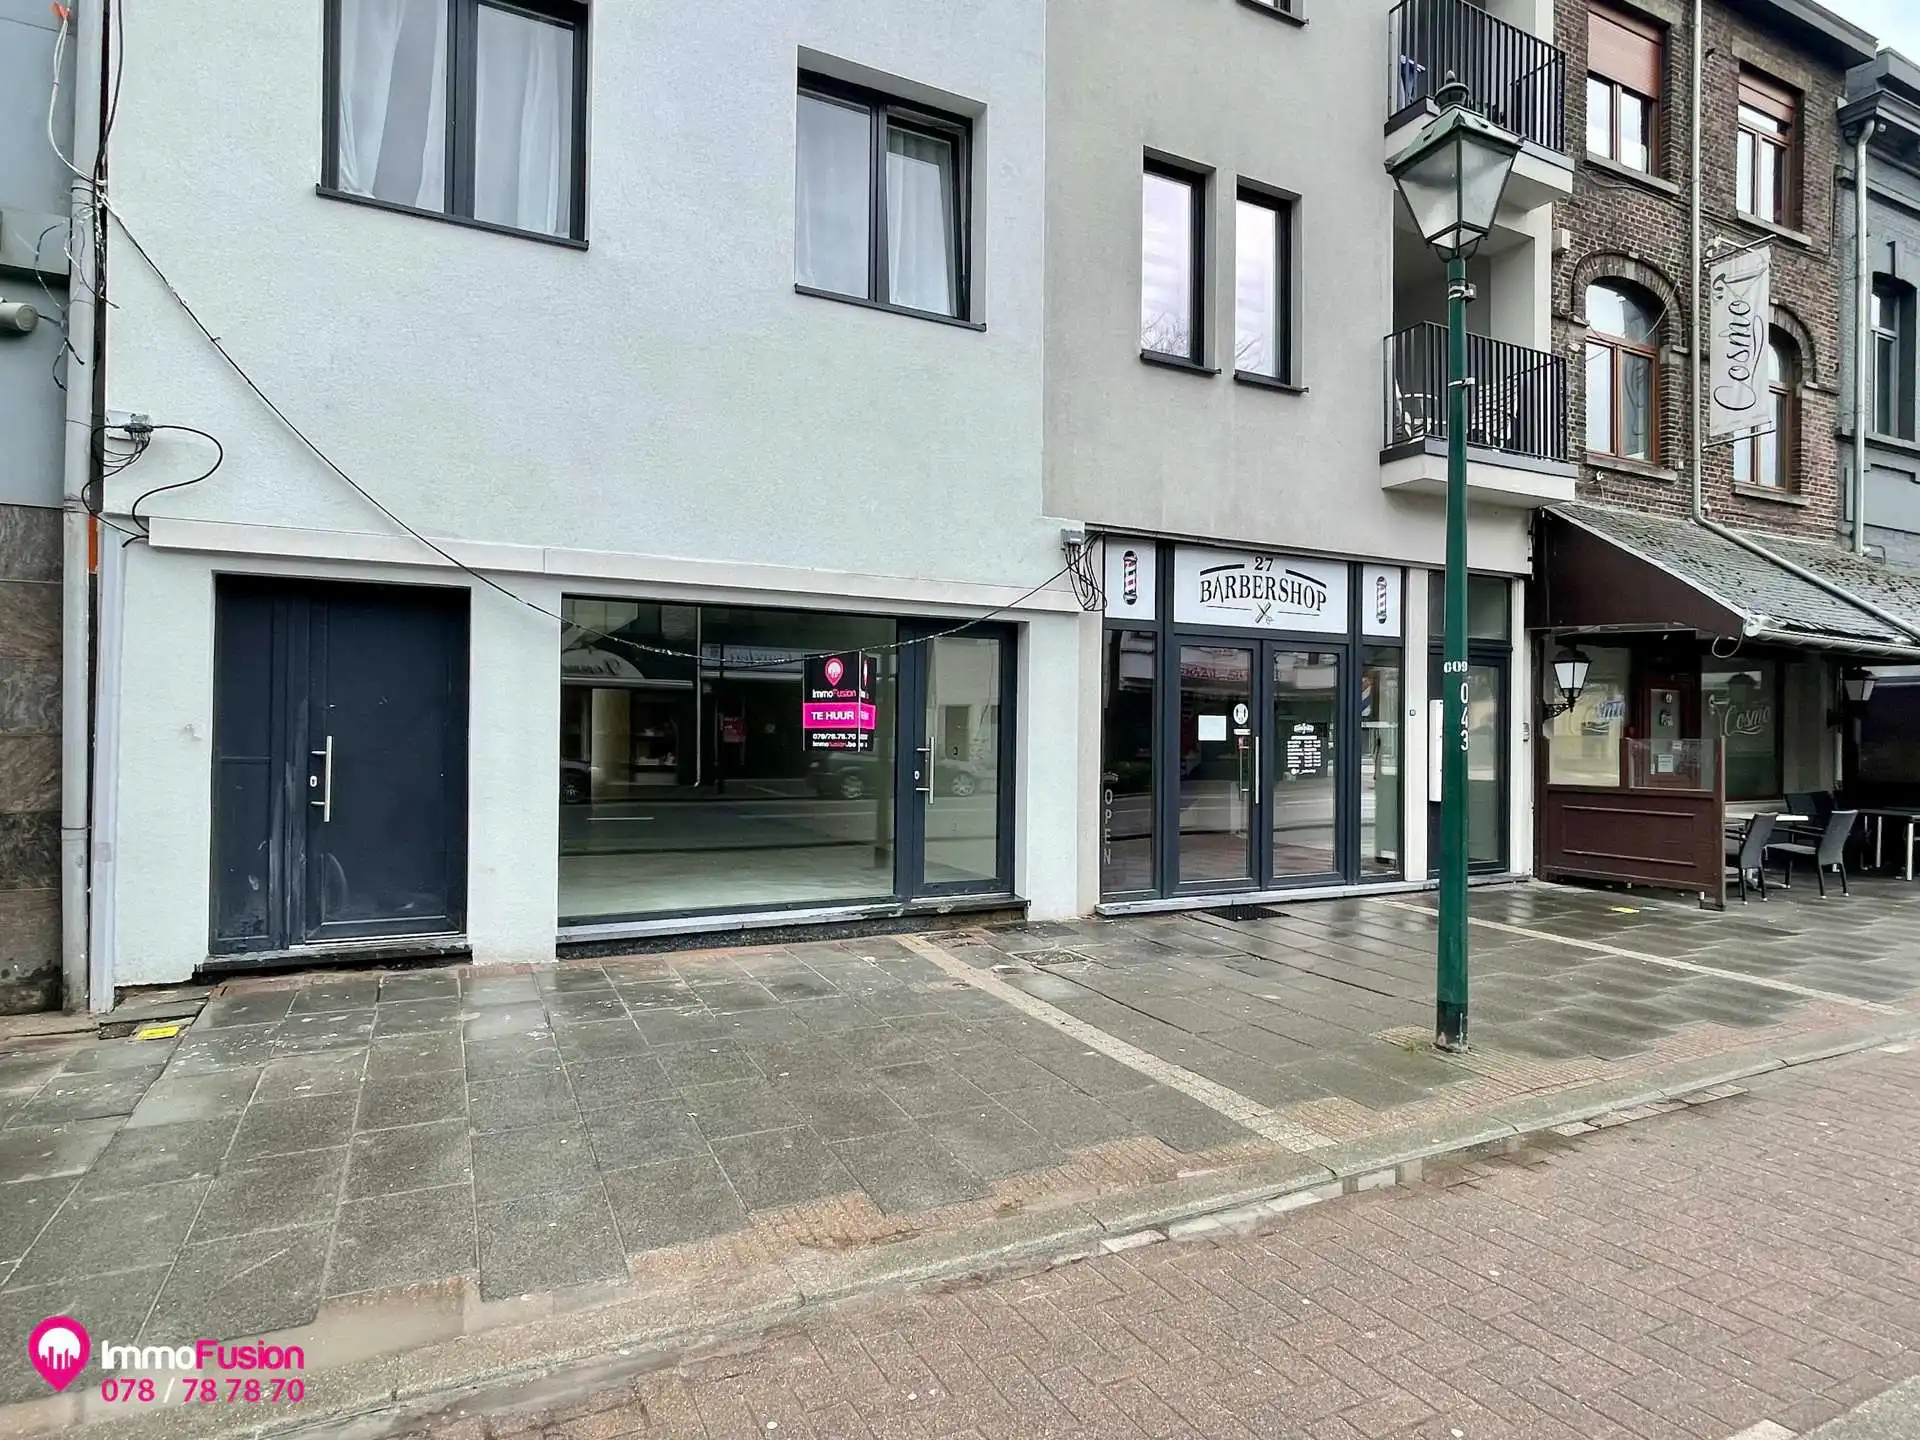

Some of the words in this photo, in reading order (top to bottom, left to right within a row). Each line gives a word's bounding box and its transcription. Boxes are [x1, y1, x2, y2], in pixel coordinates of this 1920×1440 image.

[1713, 300, 1764, 411] Cosmo
[1254, 555, 1275, 573] 27
[1200, 573, 1327, 612] BARBERSHOP
[811, 711, 824, 721] TE
[825, 711, 855, 721] HUUR
[1460, 682, 1469, 751] 043
[1724, 704, 1771, 737] Cosmo
[1104, 788, 1113, 865] OPEN
